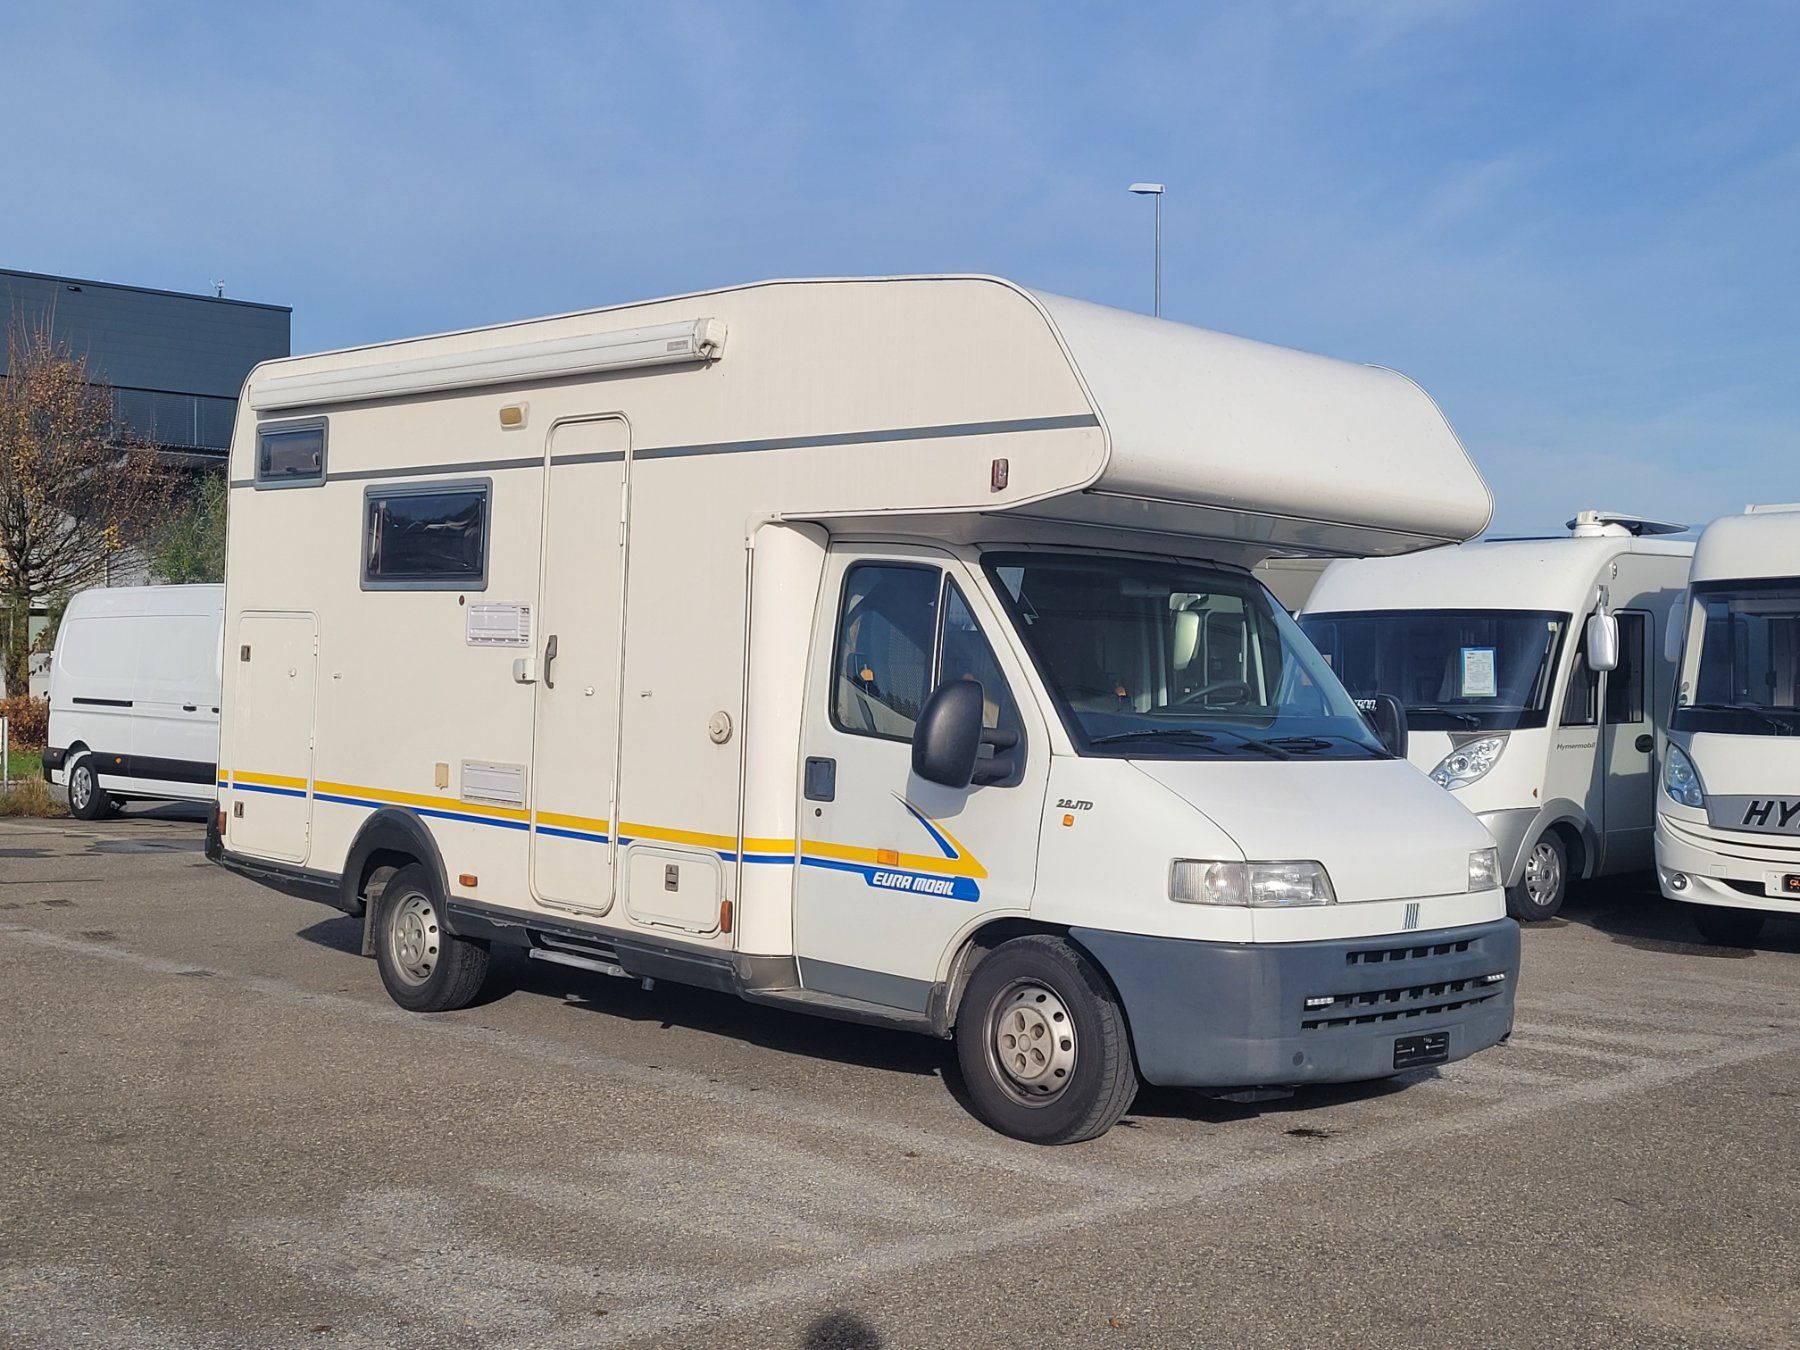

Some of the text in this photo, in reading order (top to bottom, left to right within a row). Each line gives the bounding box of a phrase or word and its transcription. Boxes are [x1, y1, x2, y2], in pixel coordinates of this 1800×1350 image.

[1556, 741, 1595, 751] Hymermobil
[1740, 800, 1800, 829] HY
[872, 871, 955, 896] EURA MOBIL
